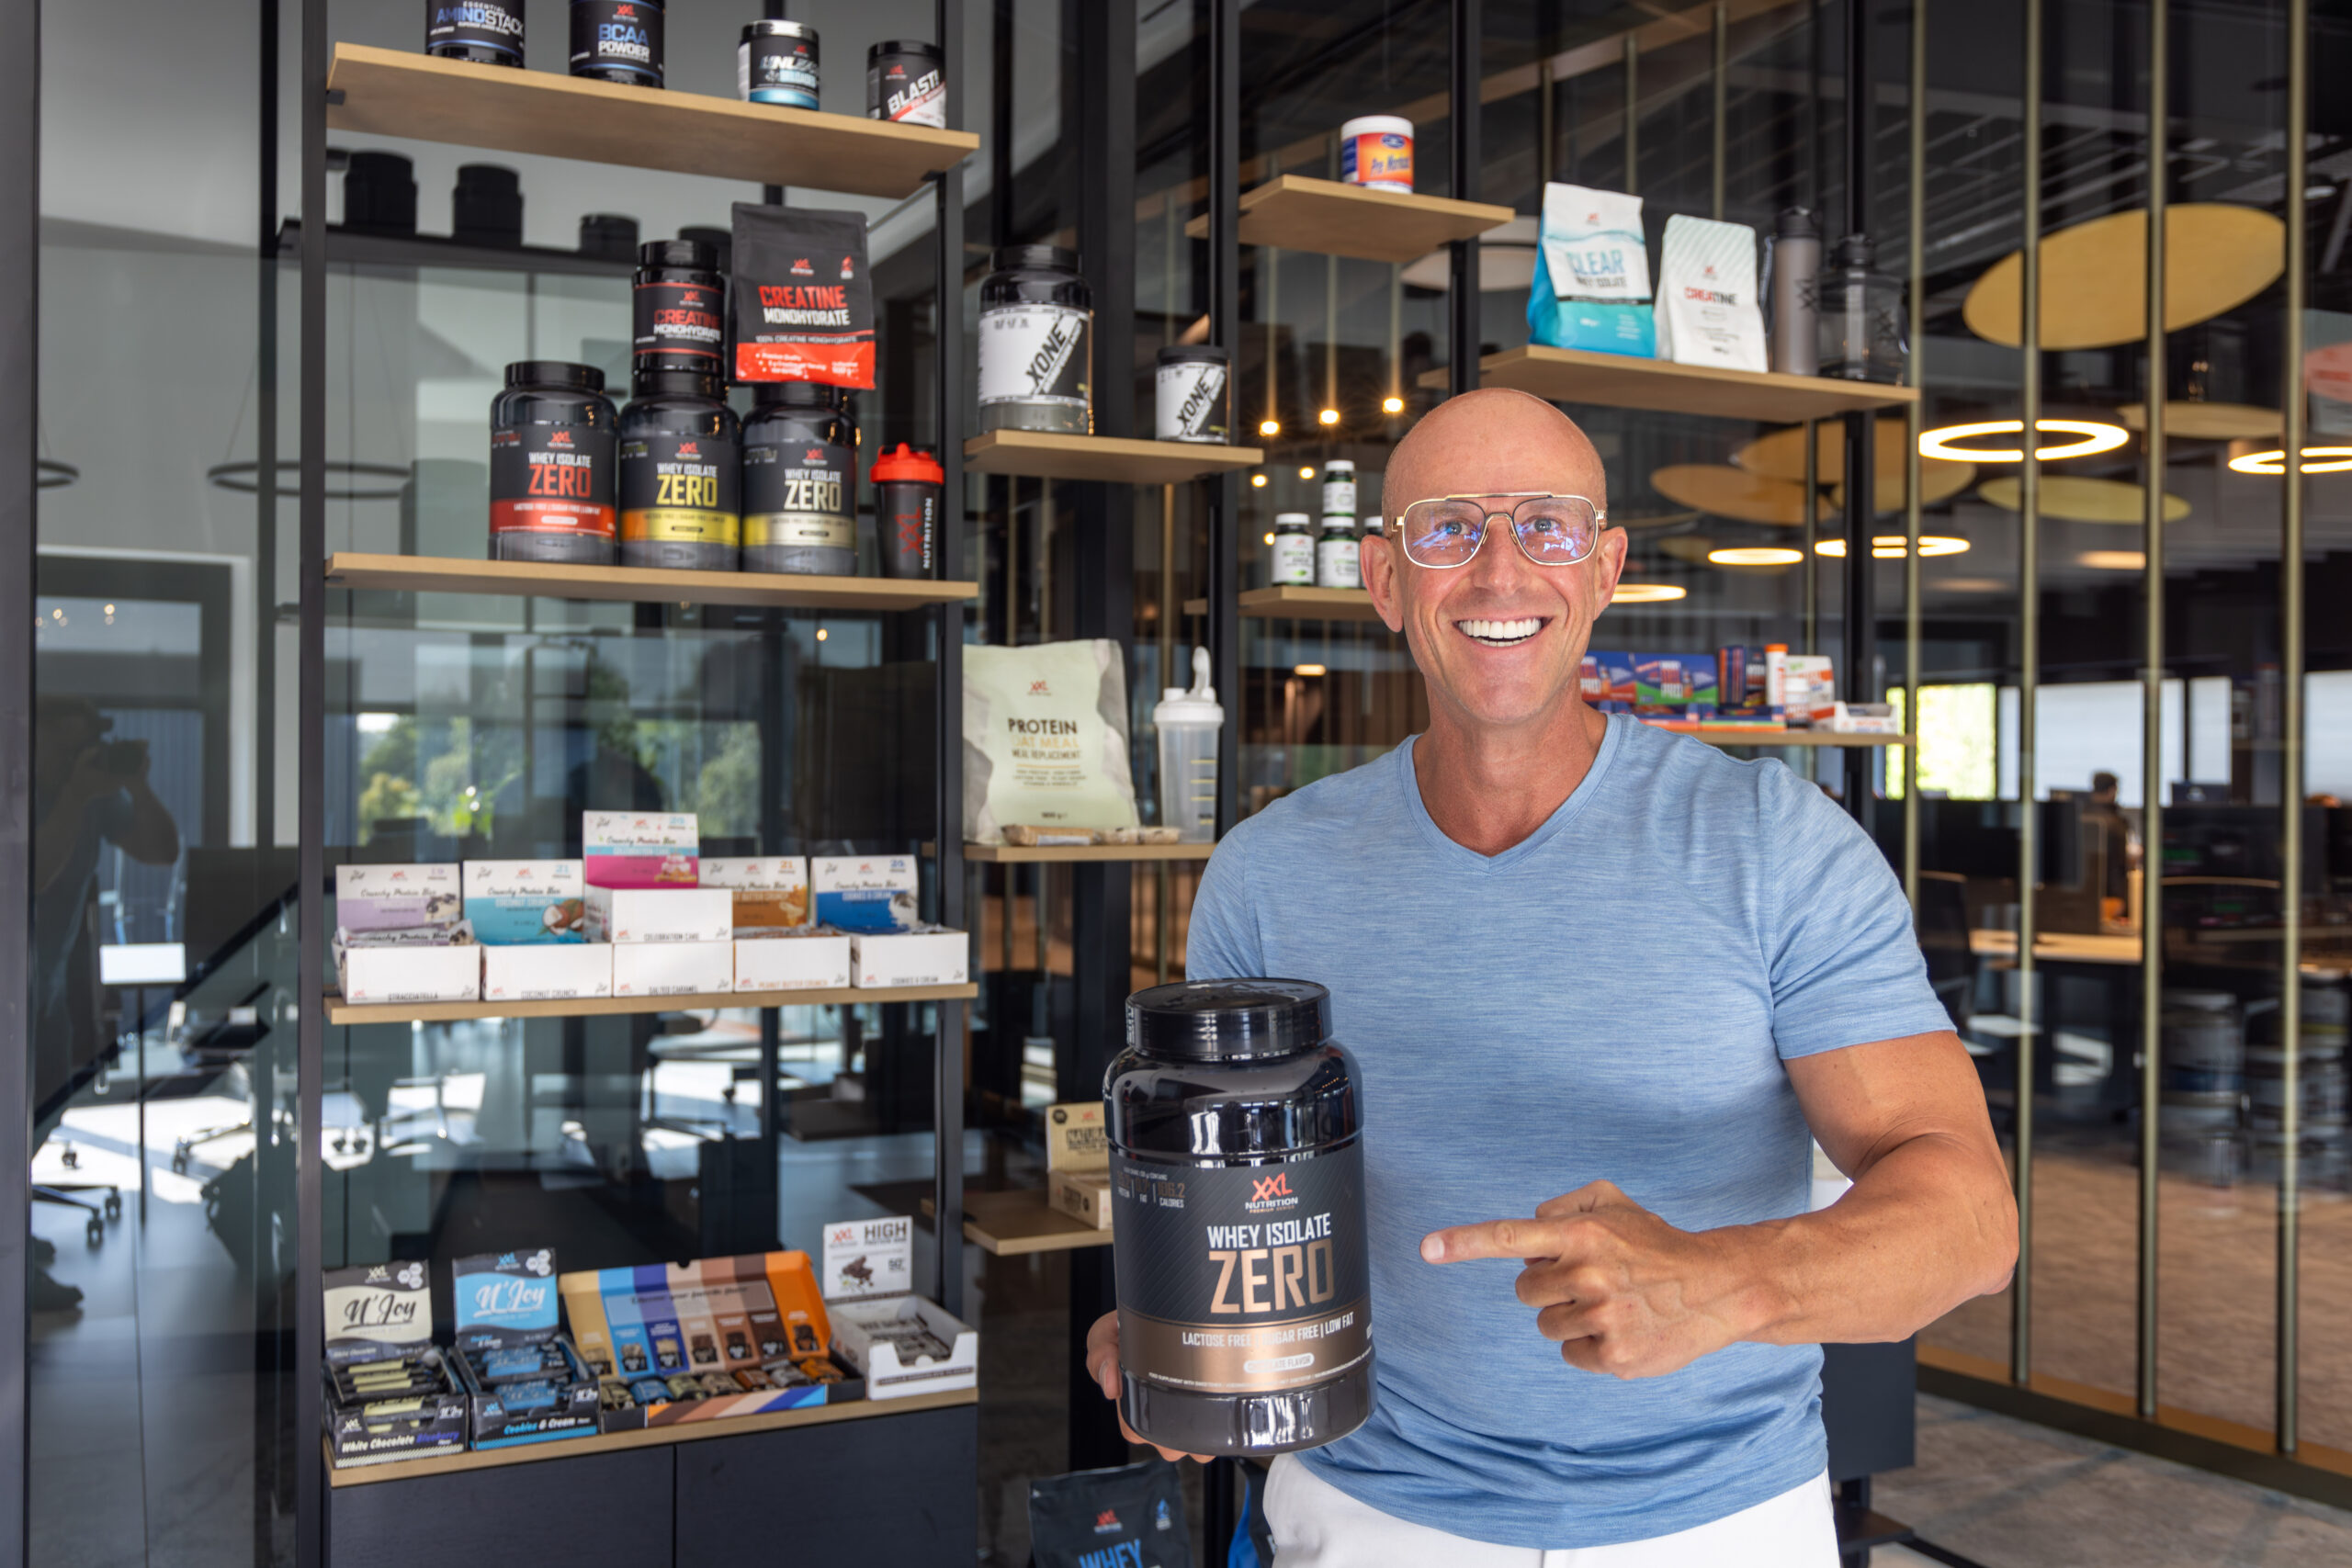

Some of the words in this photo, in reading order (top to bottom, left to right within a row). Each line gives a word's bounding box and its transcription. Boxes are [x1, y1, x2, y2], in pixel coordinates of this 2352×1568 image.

[598, 23, 649, 46] BCAA
[598, 40, 650, 59] POWDER
[887, 69, 939, 116] BLAST!
[758, 285, 848, 310] CREATINE
[654, 309, 720, 329] CREATINE
[763, 307, 851, 326] MONOHYDRATE
[1025, 322, 1067, 388] XONE
[528, 452, 555, 465] WHEY
[556, 453, 592, 468] ISOLATE
[657, 462, 683, 475] WHEY
[684, 464, 717, 478] ISOLATE
[527, 464, 592, 498] ZERO
[784, 468, 810, 480] WHEY
[810, 469, 842, 483] ISOLATE
[656, 474, 718, 507] ZERO
[784, 479, 842, 512] ZERO
[923, 497, 933, 569] NUTRITION
[1008, 717, 1078, 735] PROTEIN
[1251, 1172, 1294, 1202] XXL
[1159, 1197, 1184, 1208] CALORIES
[1245, 1196, 1298, 1210] NUTRITION
[865, 1221, 907, 1240] HIGH
[1206, 1224, 1261, 1249] WHEY
[1266, 1213, 1331, 1247] ISOLATE
[368, 1265, 389, 1279] XXL
[1208, 1238, 1334, 1314] ZERO
[475, 1279, 547, 1312] N'Joy
[345, 1293, 416, 1325] N'Joy
[1182, 1332, 1226, 1348] LACTOSE
[1227, 1334, 1252, 1348] FREE
[1262, 1329, 1295, 1344] SUGAR
[1297, 1325, 1319, 1341] FREE
[1325, 1316, 1341, 1335] LOW
[1342, 1312, 1354, 1328] FAT
[1287, 1355, 1311, 1368] FLAVOR
[503, 1422, 537, 1435] Cookies
[548, 1417, 575, 1428] Cream
[342, 1441, 368, 1453] White
[370, 1435, 415, 1450] Chocolate
[416, 1431, 460, 1443] Blueberry
